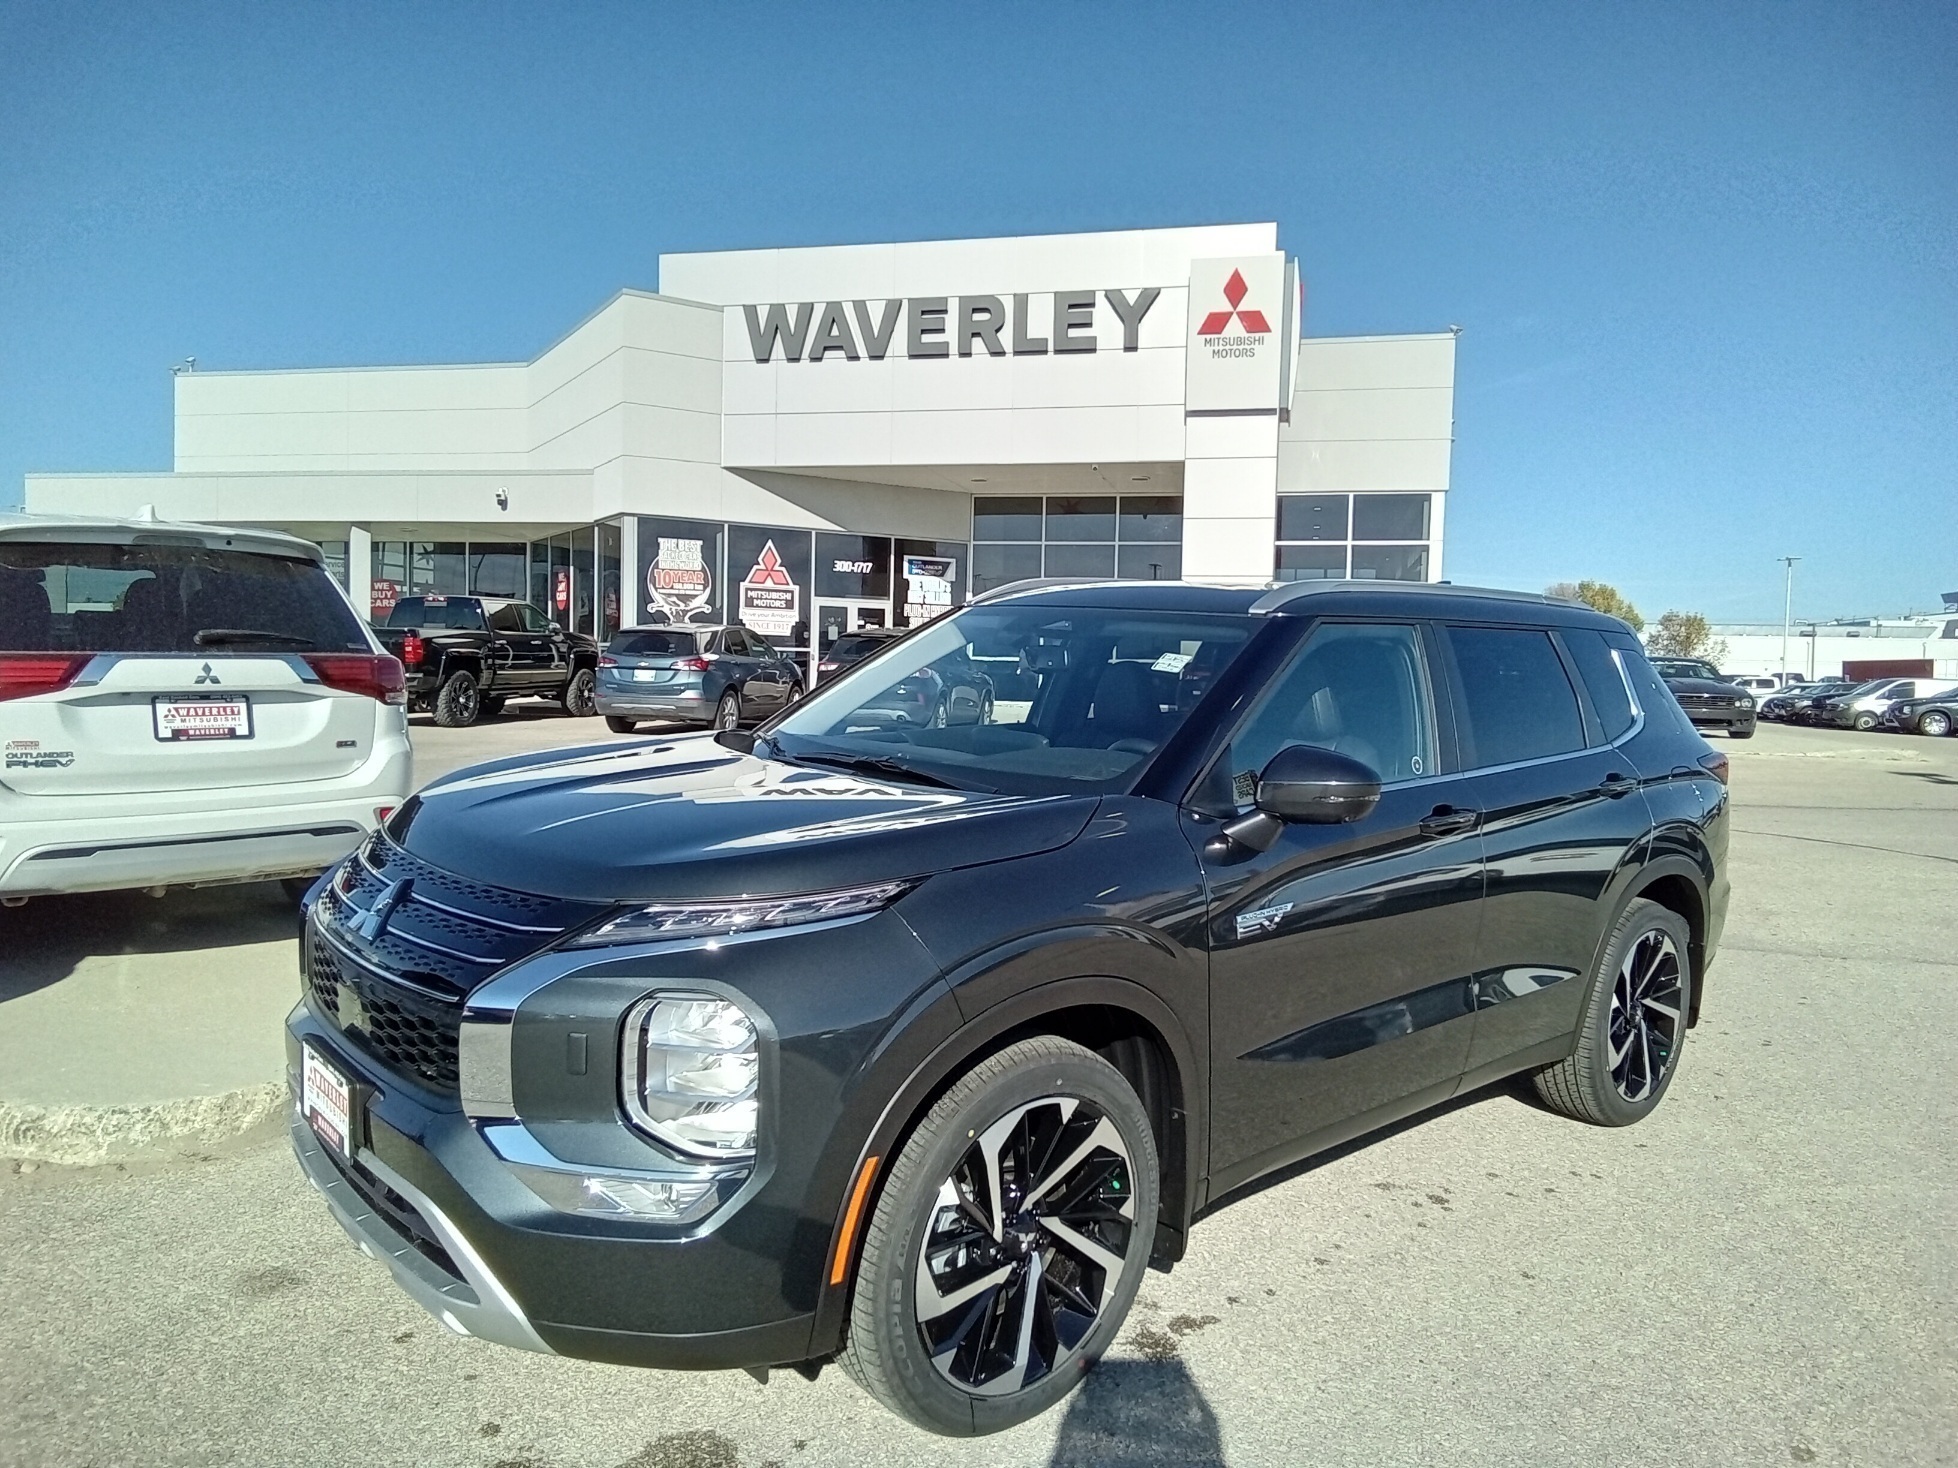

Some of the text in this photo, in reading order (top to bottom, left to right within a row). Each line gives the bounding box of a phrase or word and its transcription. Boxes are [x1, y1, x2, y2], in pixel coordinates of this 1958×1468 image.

[743, 288, 1161, 364] WAVERLEY
[1203, 336, 1265, 348] MITSUBISHI
[1212, 347, 1256, 359] MOTORS
[833, 560, 873, 573] 300-1717
[655, 570, 704, 588] 10 YEAR
[374, 582, 390, 590] WE
[748, 590, 791, 600] MITSUBISHI
[753, 599, 786, 608] MOTORS
[178, 707, 239, 716] WAVERLEY
[188, 728, 229, 736] WAVERLEY
[6, 759, 75, 768] PHEV
[1237, 912, 1284, 940] EV
